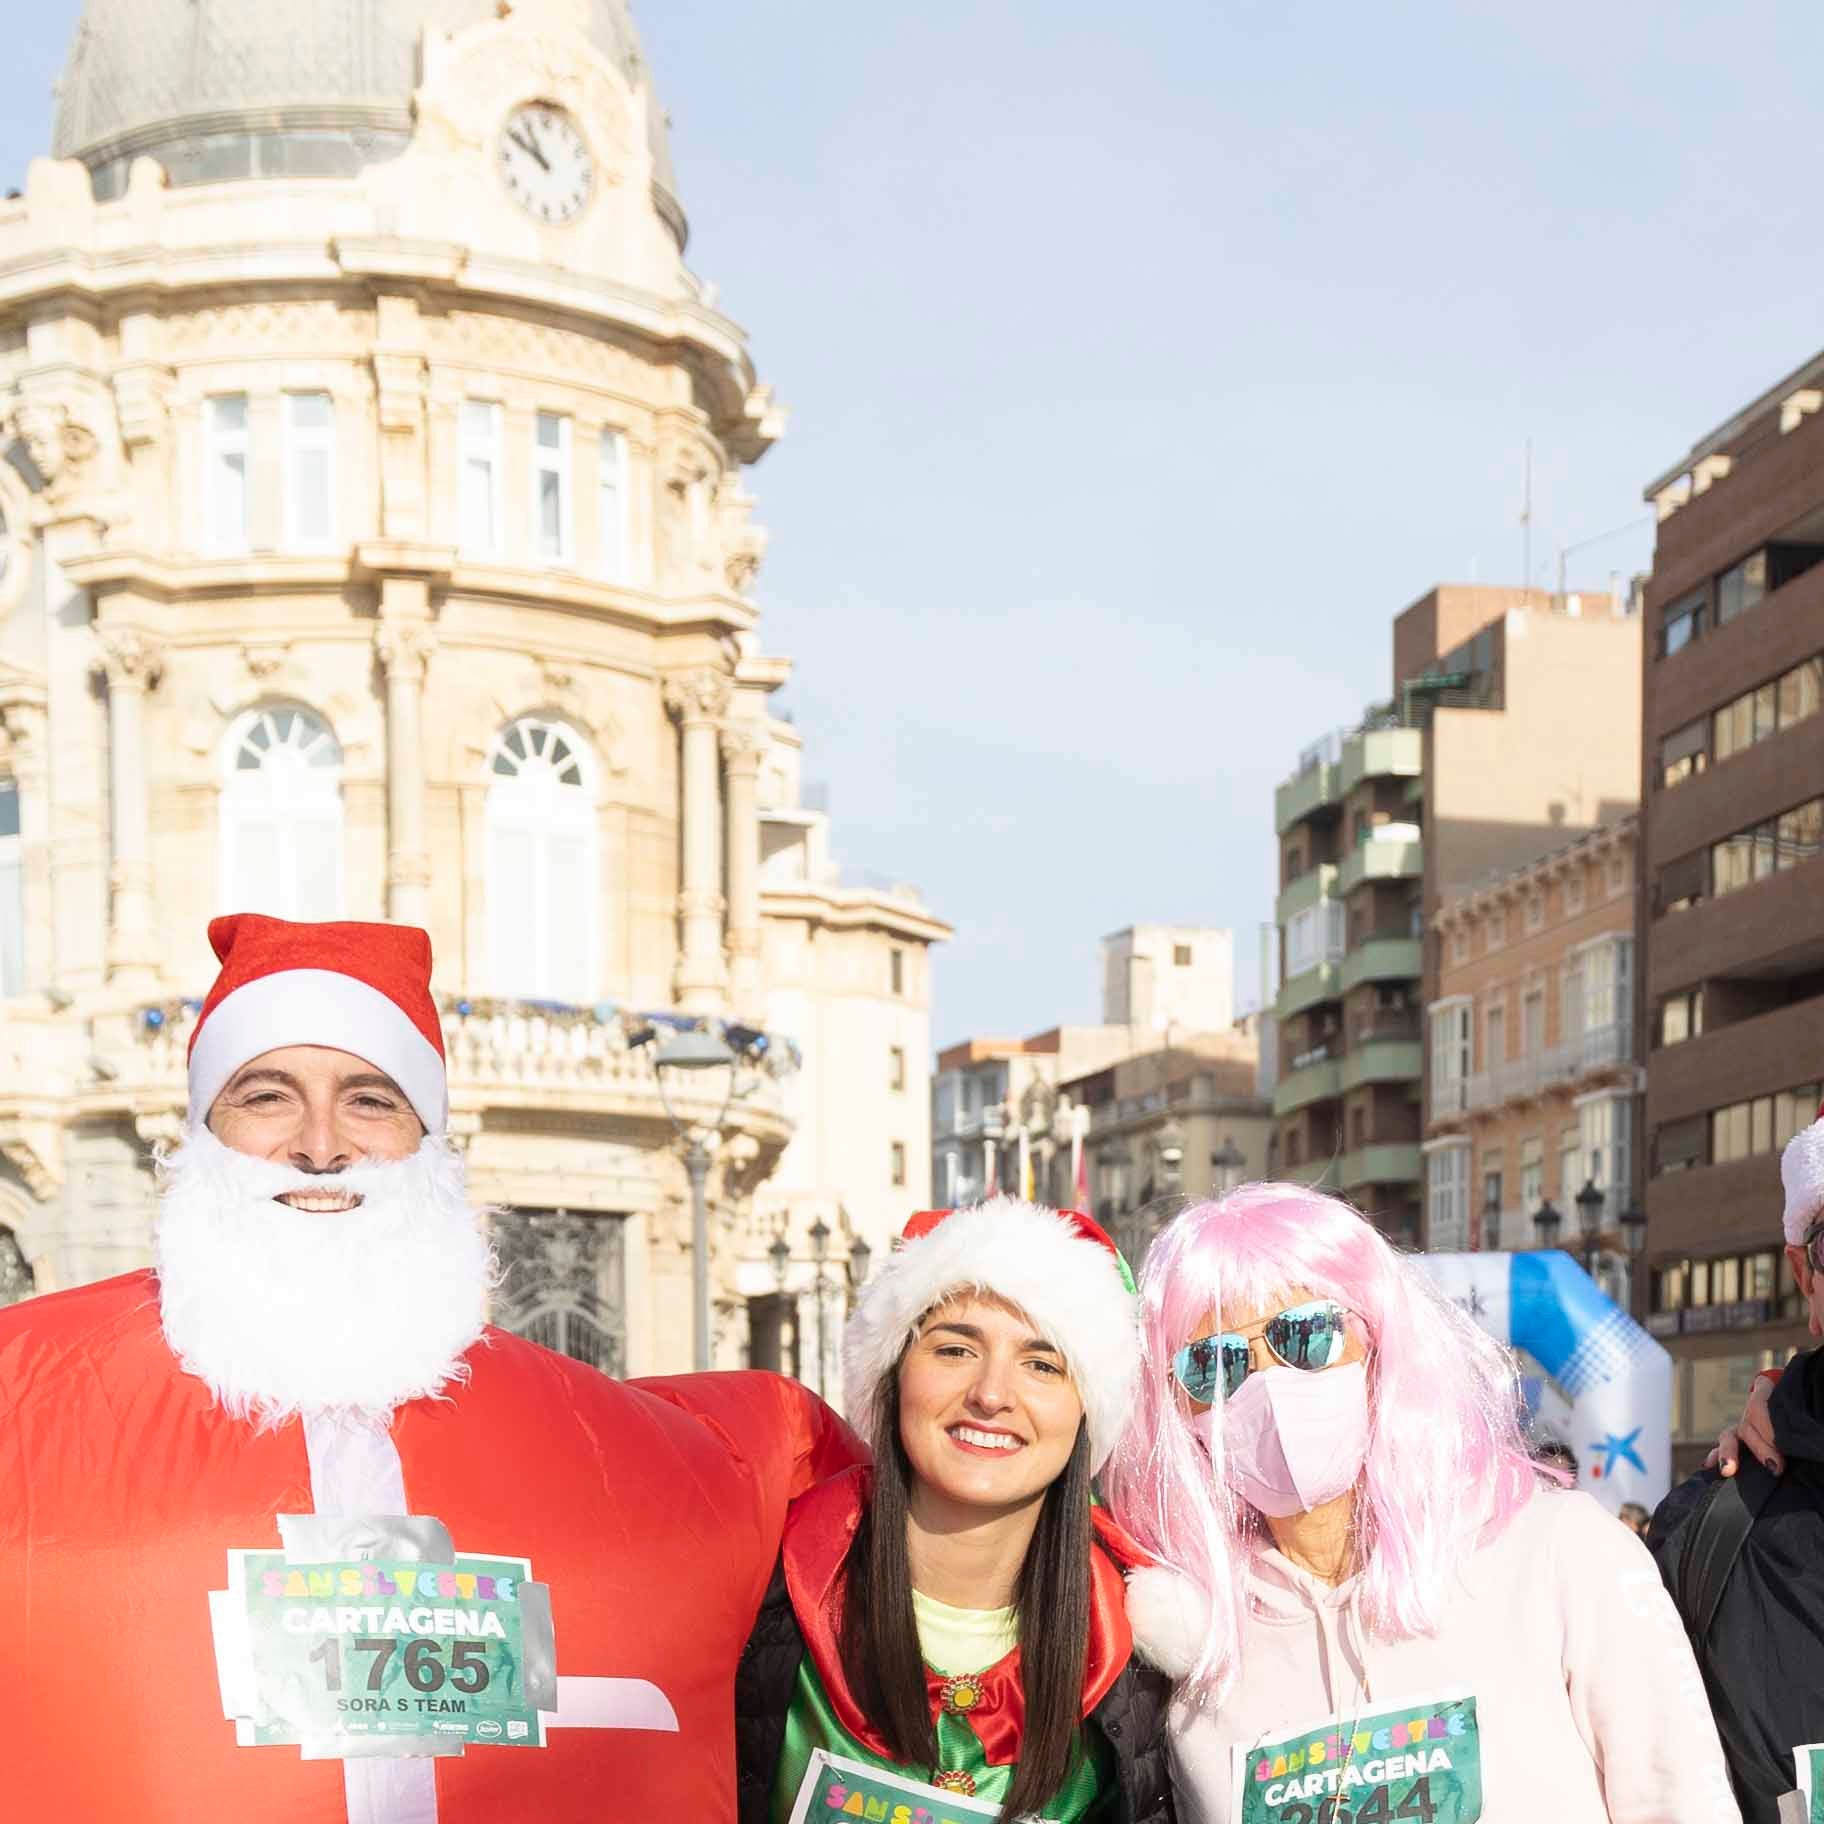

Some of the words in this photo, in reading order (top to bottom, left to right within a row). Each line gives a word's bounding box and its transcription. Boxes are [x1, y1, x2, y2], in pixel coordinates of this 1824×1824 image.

[261, 1569, 336, 1600] SAN
[284, 1605, 505, 1637] CARTAGENA
[308, 1638, 491, 1695] 1765
[336, 1698, 391, 1713] SORA
[398, 1699, 409, 1713] S
[414, 1698, 466, 1714] TEAM
[1255, 1751, 1307, 1782] SAN
[1264, 1747, 1453, 1808] CARTAGENA
[825, 1783, 888, 1823] SAN
